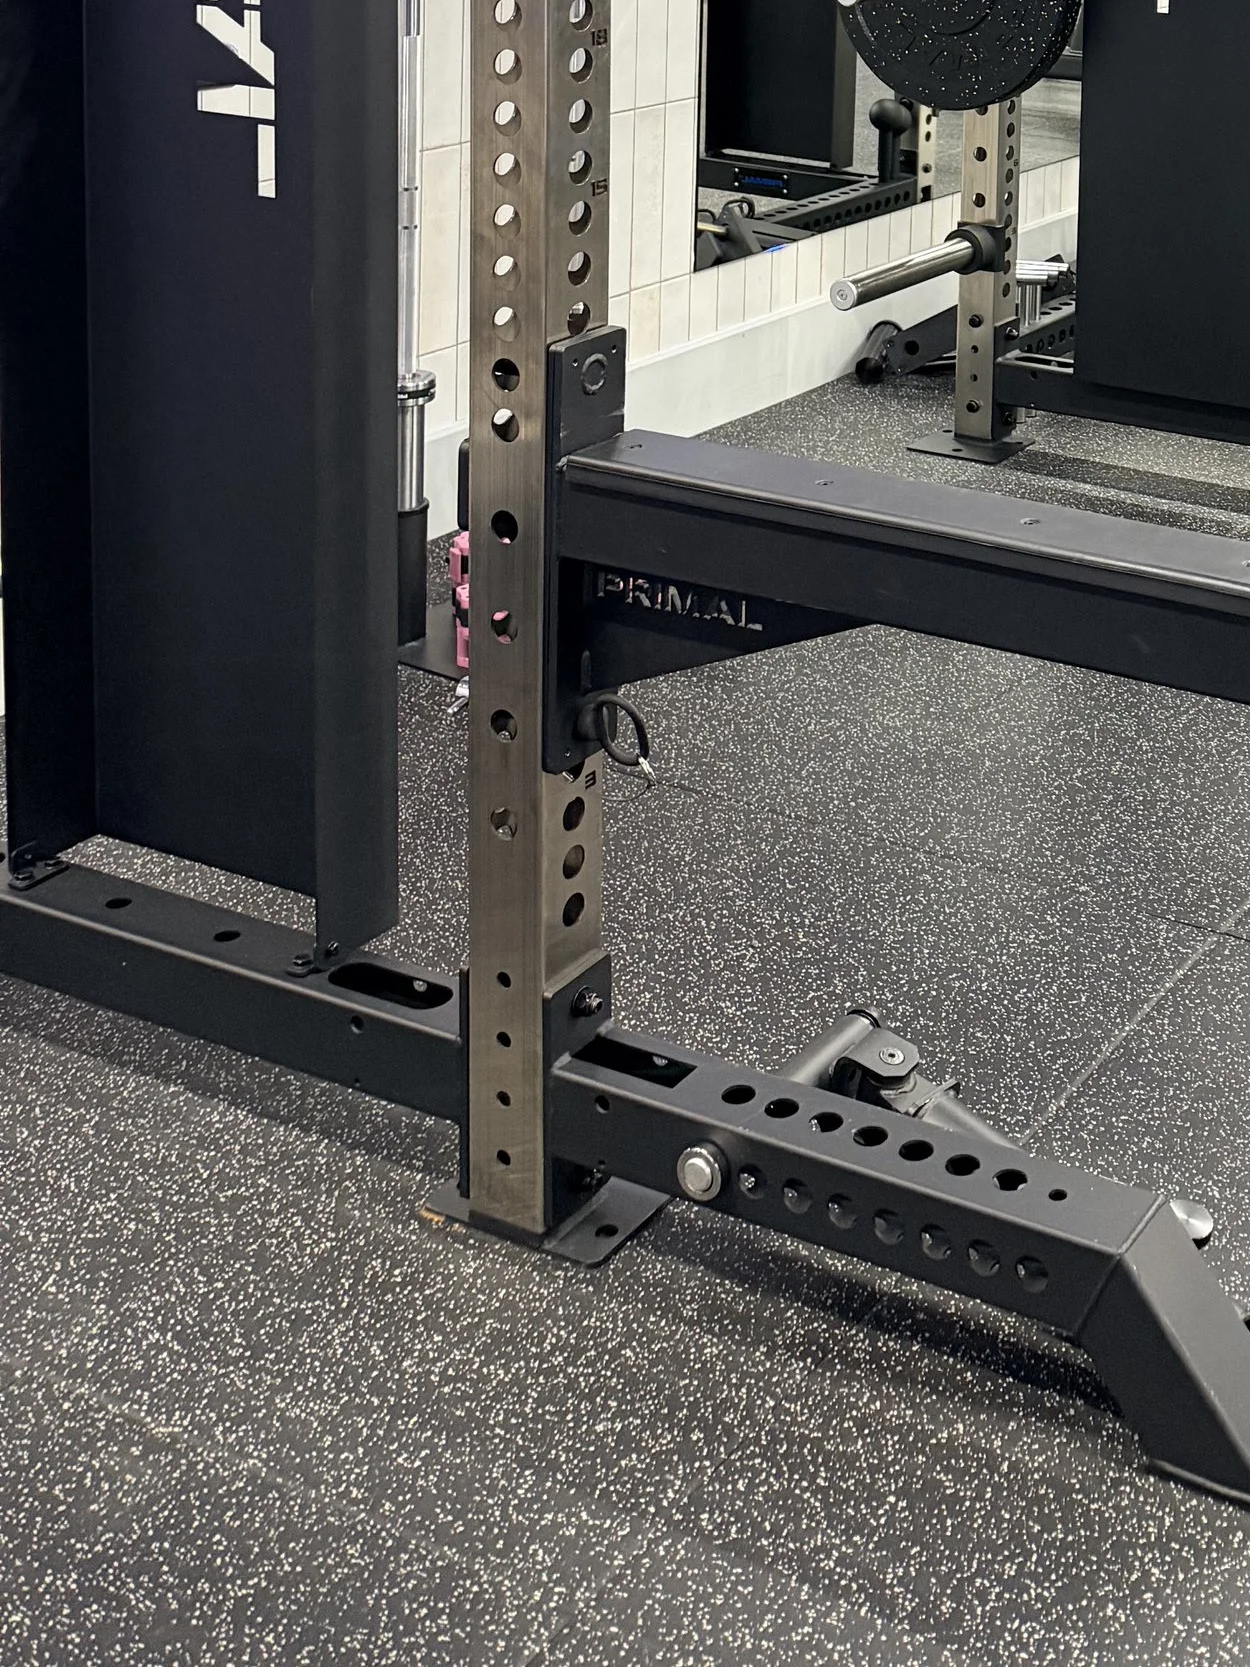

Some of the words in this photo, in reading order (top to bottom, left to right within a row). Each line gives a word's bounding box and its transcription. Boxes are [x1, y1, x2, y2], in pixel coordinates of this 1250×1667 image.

[591, 28, 608, 46] 18
[591, 178, 608, 197] 15
[597, 571, 763, 632] PRIMAL
[584, 769, 597, 790] 3
